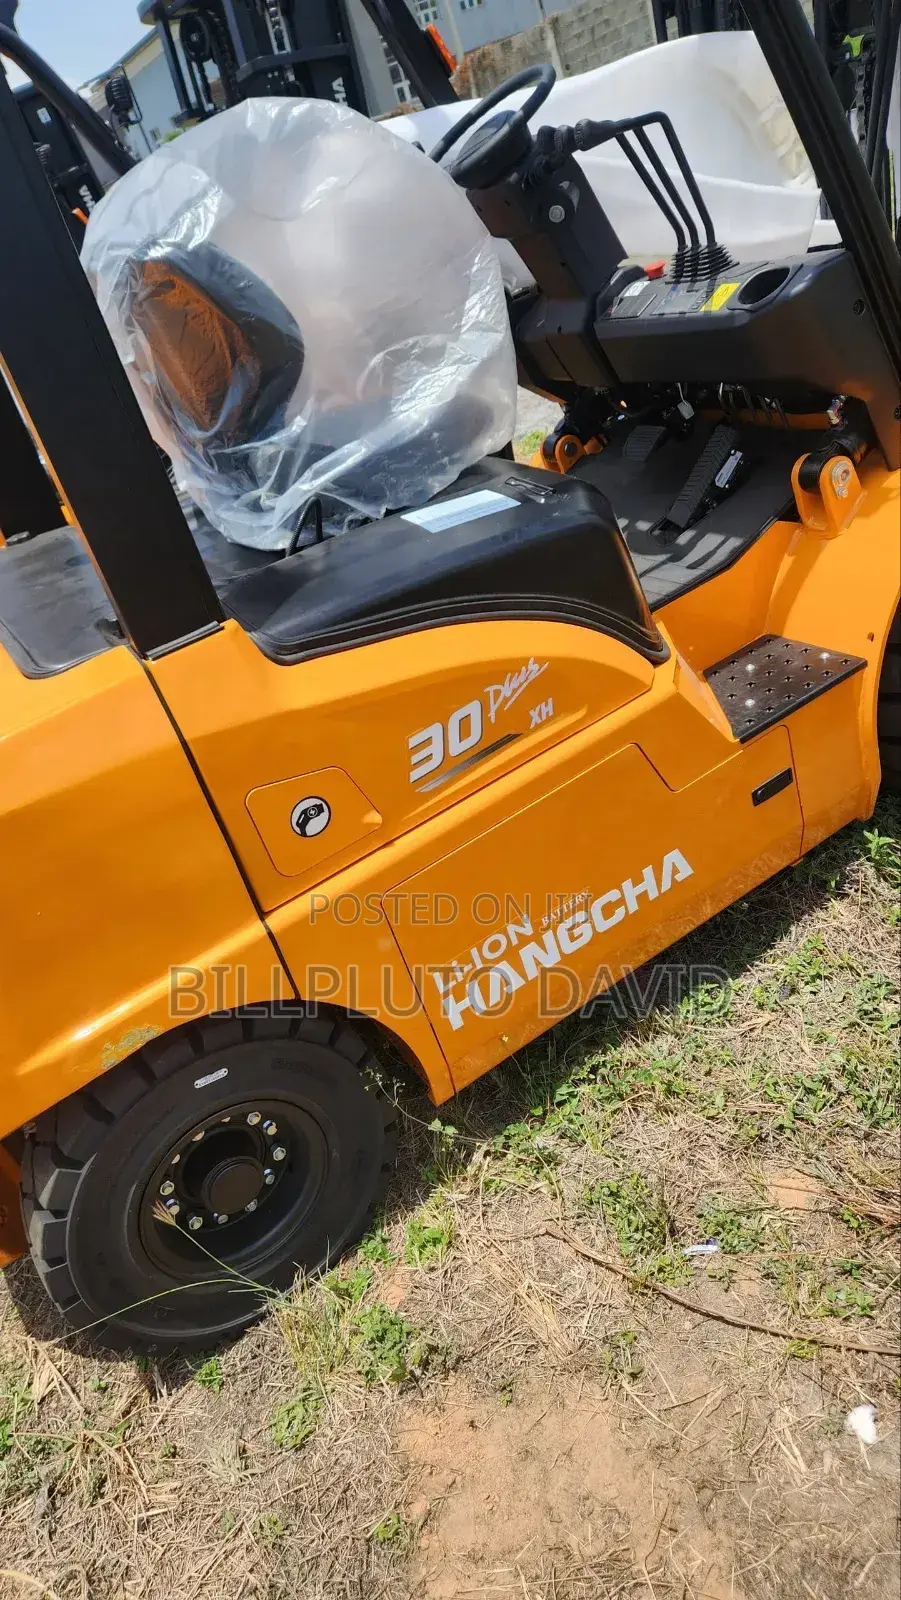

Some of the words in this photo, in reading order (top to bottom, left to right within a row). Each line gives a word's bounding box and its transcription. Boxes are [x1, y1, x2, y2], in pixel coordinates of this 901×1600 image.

[408, 699, 483, 784] 30
[484, 657, 549, 724] Plus
[529, 698, 554, 729] XH
[442, 848, 695, 1032] HANGCHA
[541, 891, 589, 926] BATTERY
